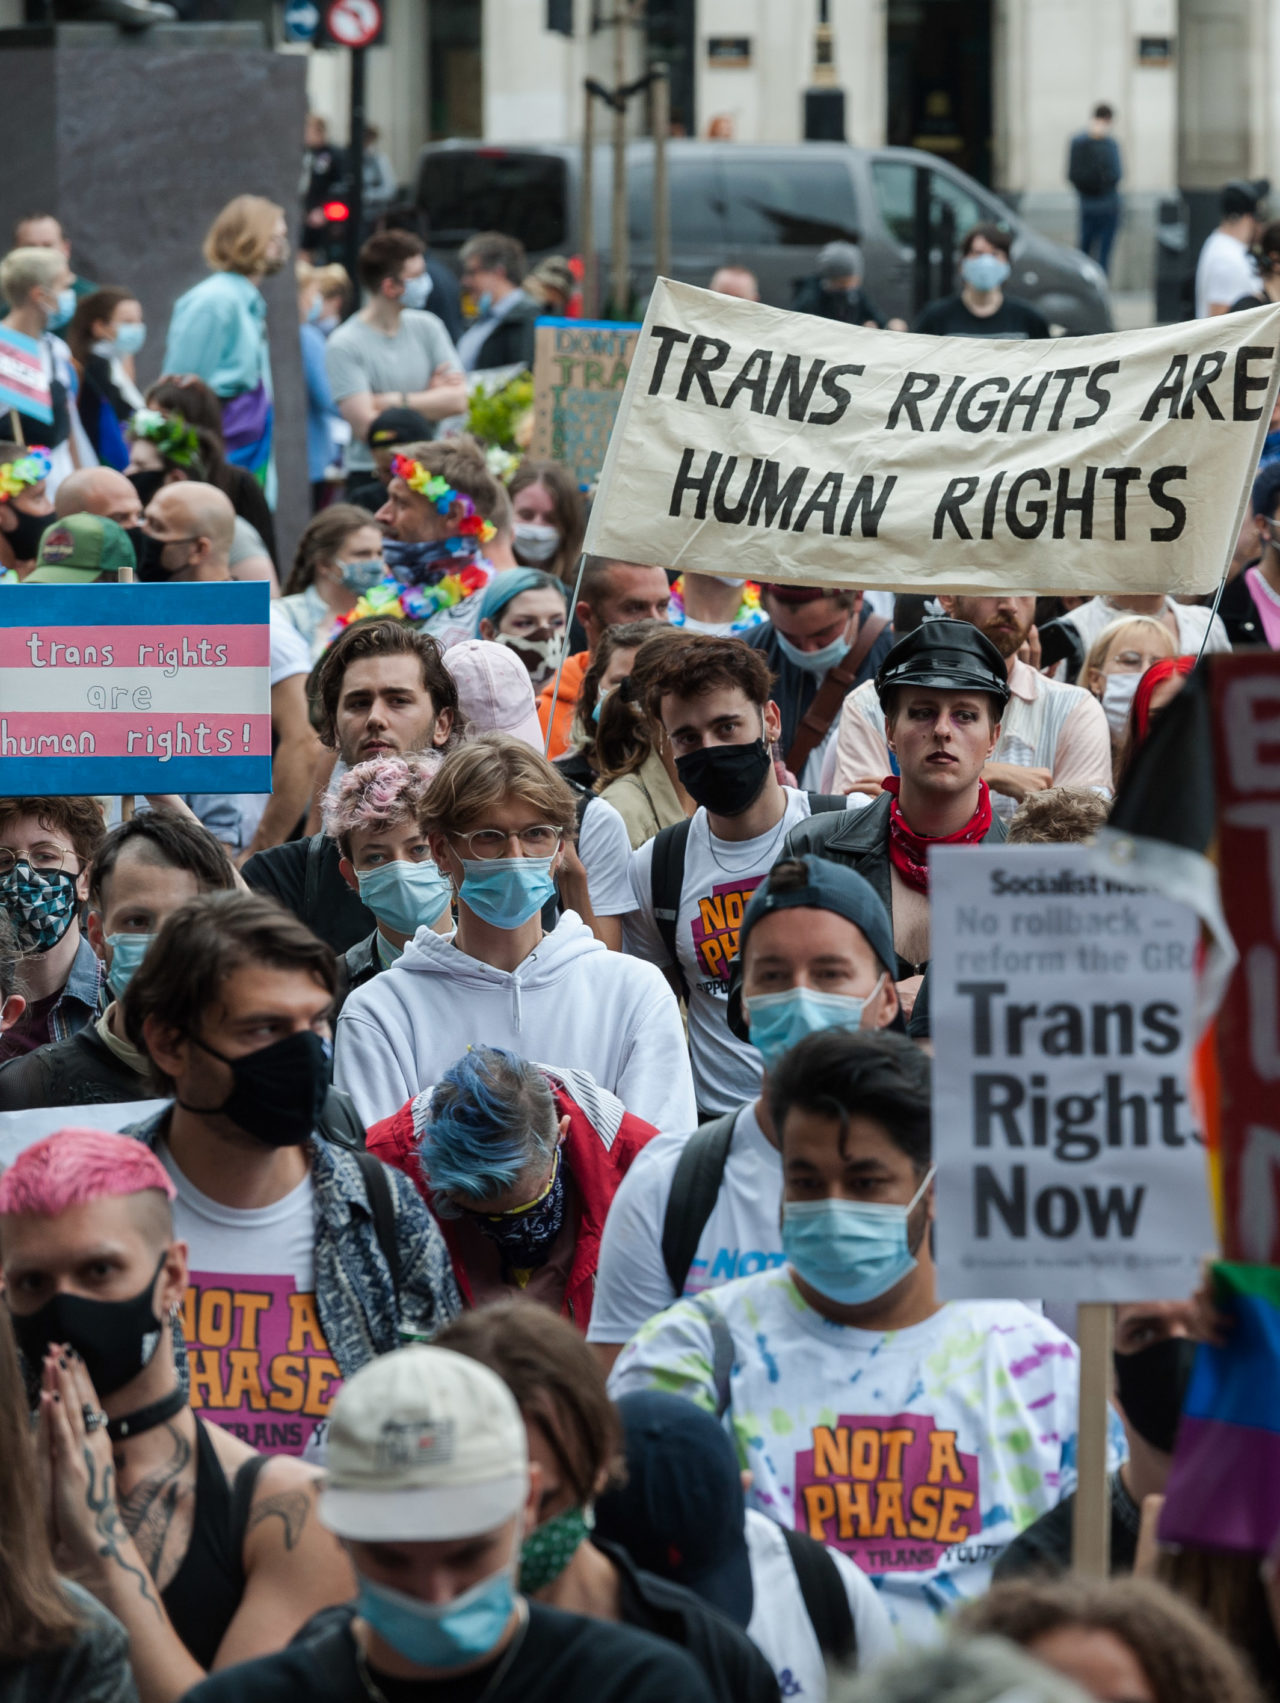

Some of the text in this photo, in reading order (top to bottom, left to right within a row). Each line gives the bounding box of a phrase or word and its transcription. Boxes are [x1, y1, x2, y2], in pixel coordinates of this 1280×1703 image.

[648, 325, 866, 426] TRANS
[884, 360, 1120, 433] RIGHTS
[1139, 345, 1275, 422] ARE
[668, 447, 1188, 543] HUMAN RIGHTS
[26, 632, 228, 678] trans rights
[86, 685, 153, 710] are
[0, 718, 251, 763] human rights!
[989, 867, 1099, 897] Socialist
[955, 905, 999, 937] No
[1011, 904, 1140, 937] rollback
[955, 943, 1193, 975] reform the GR
[956, 981, 1181, 1058] Trans
[973, 1073, 1208, 1163] Right
[973, 1165, 1146, 1241] Now
[288, 1290, 329, 1353] A
[188, 1349, 343, 1420] HASE
[812, 1425, 968, 1484] NOT A
[803, 1479, 977, 1544] PHASE
[866, 1549, 936, 1568] TRANS
